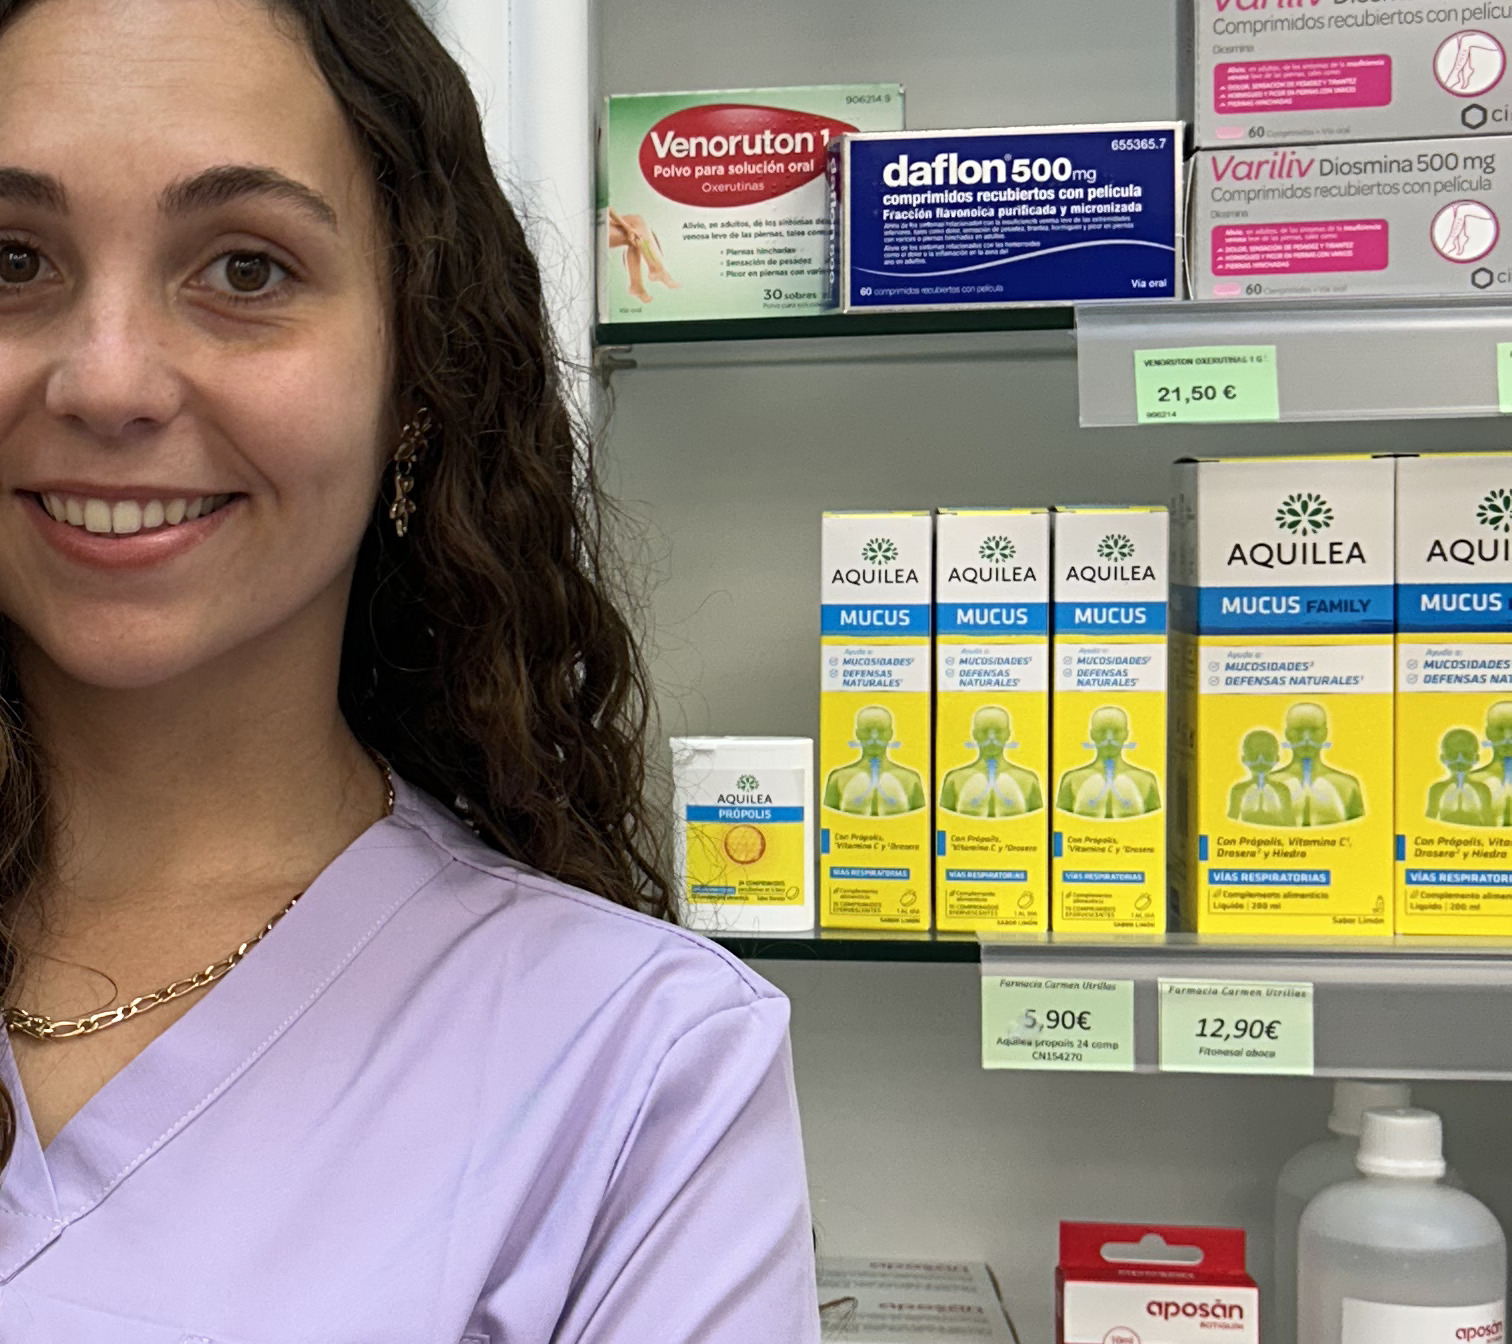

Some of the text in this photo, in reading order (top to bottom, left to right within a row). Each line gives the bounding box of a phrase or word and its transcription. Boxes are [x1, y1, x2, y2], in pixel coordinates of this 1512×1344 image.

[649, 130, 815, 160] Venoruton
[1111, 137, 1167, 151] 655365.7
[653, 158, 815, 179] Polvo para solución oral
[882, 156, 1007, 187] daflon
[1211, 149, 1496, 183] Variliv Diosmina 500 mg
[882, 183, 1142, 209] comprimidos recubiertos con película
[1157, 384, 1237, 404] 21,50 €
[1227, 541, 1366, 569] AQUILEA
[832, 566, 919, 587] AQUILEA
[1221, 594, 1371, 617] MUCUS FAMILY
[840, 608, 910, 628] MUCUS
[718, 808, 772, 820] PRÓPOLIS
[1023, 1008, 1092, 1032] 5,90€
[1195, 1017, 1282, 1042] 12,90€
